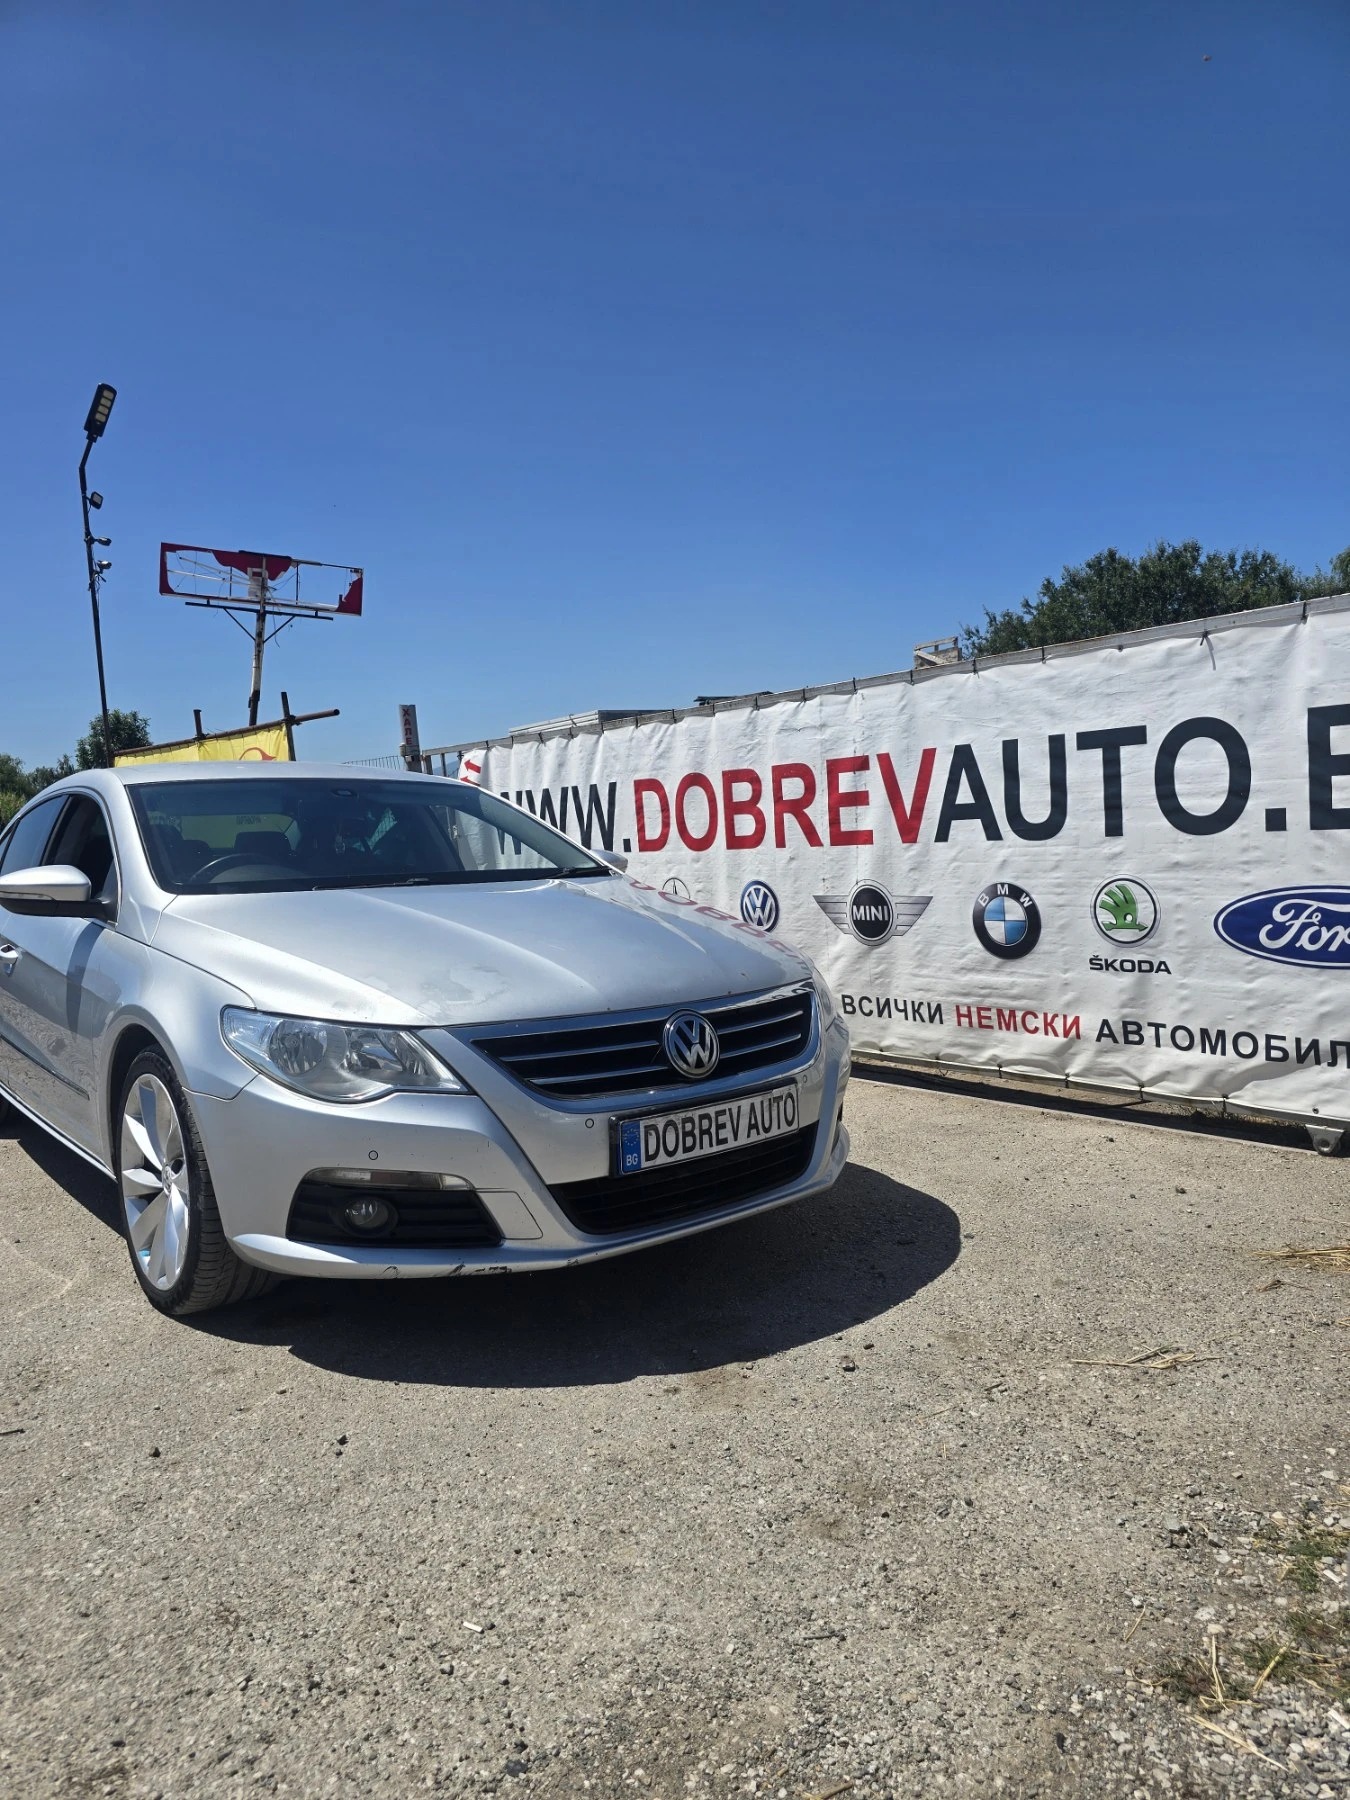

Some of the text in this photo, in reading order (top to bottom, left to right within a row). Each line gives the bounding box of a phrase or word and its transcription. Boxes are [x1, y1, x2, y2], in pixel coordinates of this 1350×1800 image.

[978, 883, 1033, 908] BMW
[852, 904, 889, 922] MINI
[1259, 899, 1350, 951] For
[1089, 955, 1172, 975] ŠKODA
[842, 994, 1350, 1069] ВСИЧКИ НЕМСКИ АВТОМОБИЛ
[643, 1091, 796, 1162] DOBREV AUTO
[626, 1154, 639, 1166] BG
